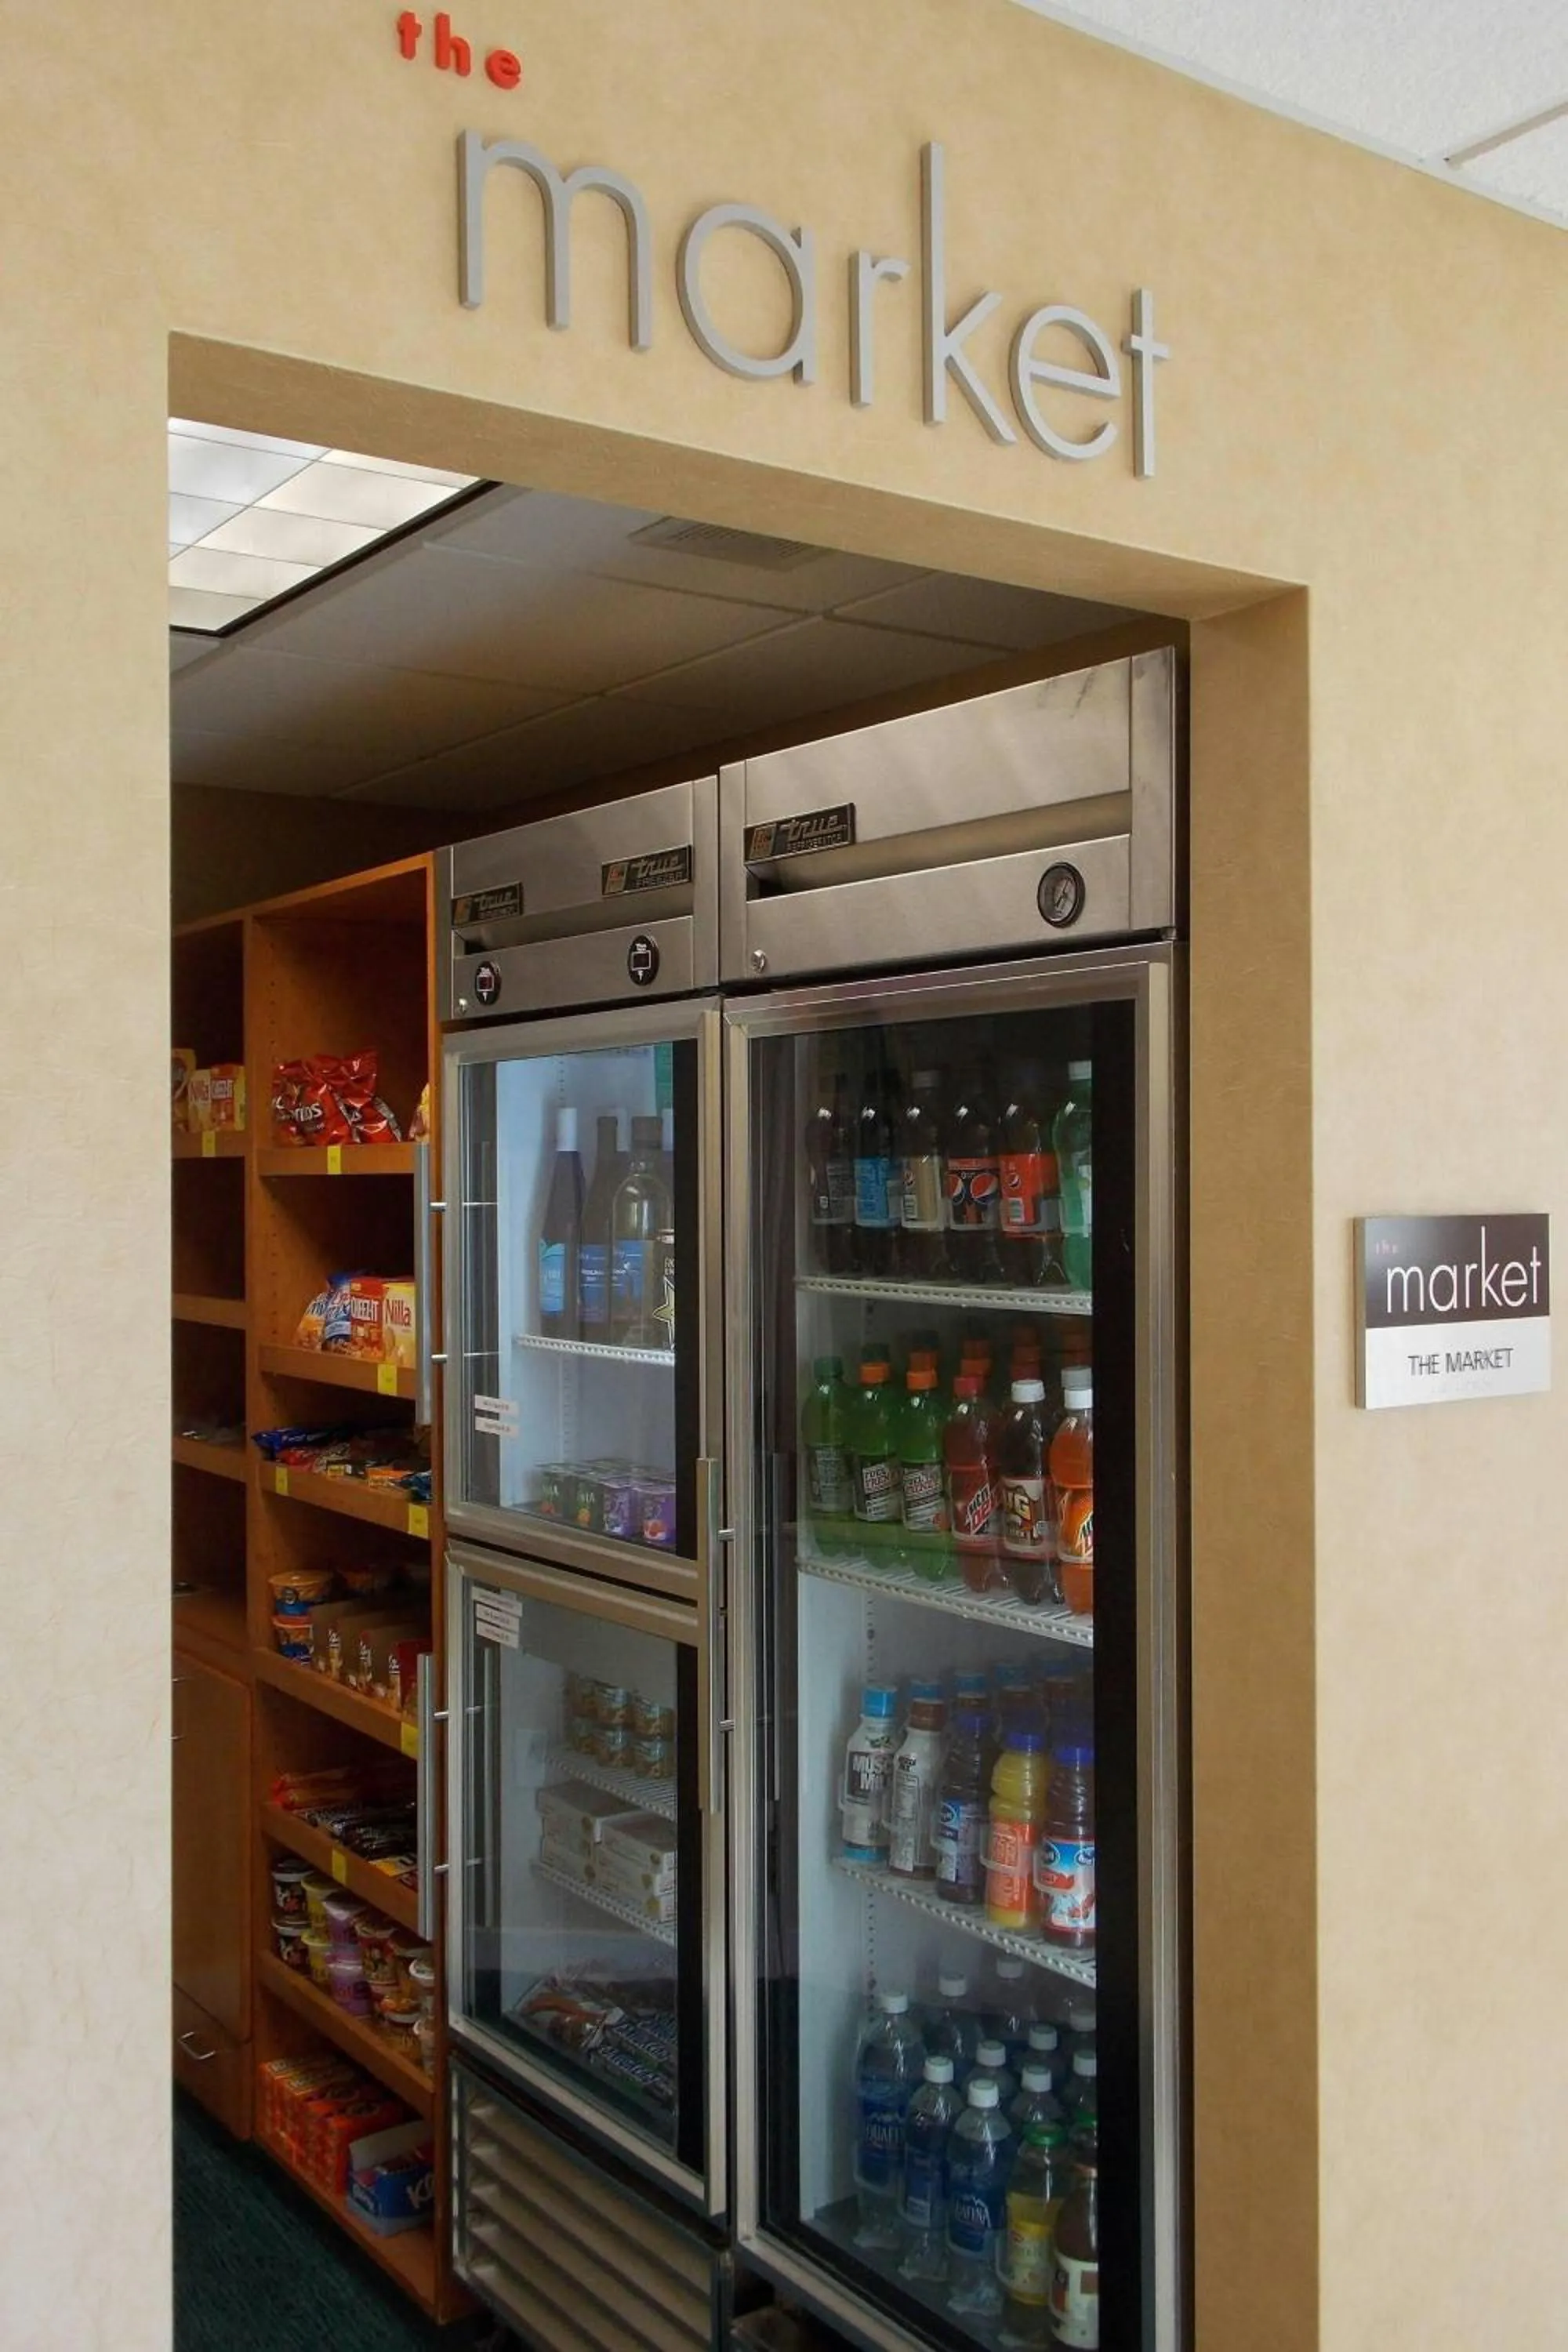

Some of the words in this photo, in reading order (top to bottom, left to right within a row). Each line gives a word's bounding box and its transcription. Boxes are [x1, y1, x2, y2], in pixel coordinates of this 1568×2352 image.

[396, 10, 523, 89] the
[456, 128, 1171, 480] market
[1386, 1225, 1542, 1313] market
[386, 1298, 412, 1327] Nilla
[1408, 1354, 1440, 1376] THE
[1446, 1348, 1515, 1374] MARKET
